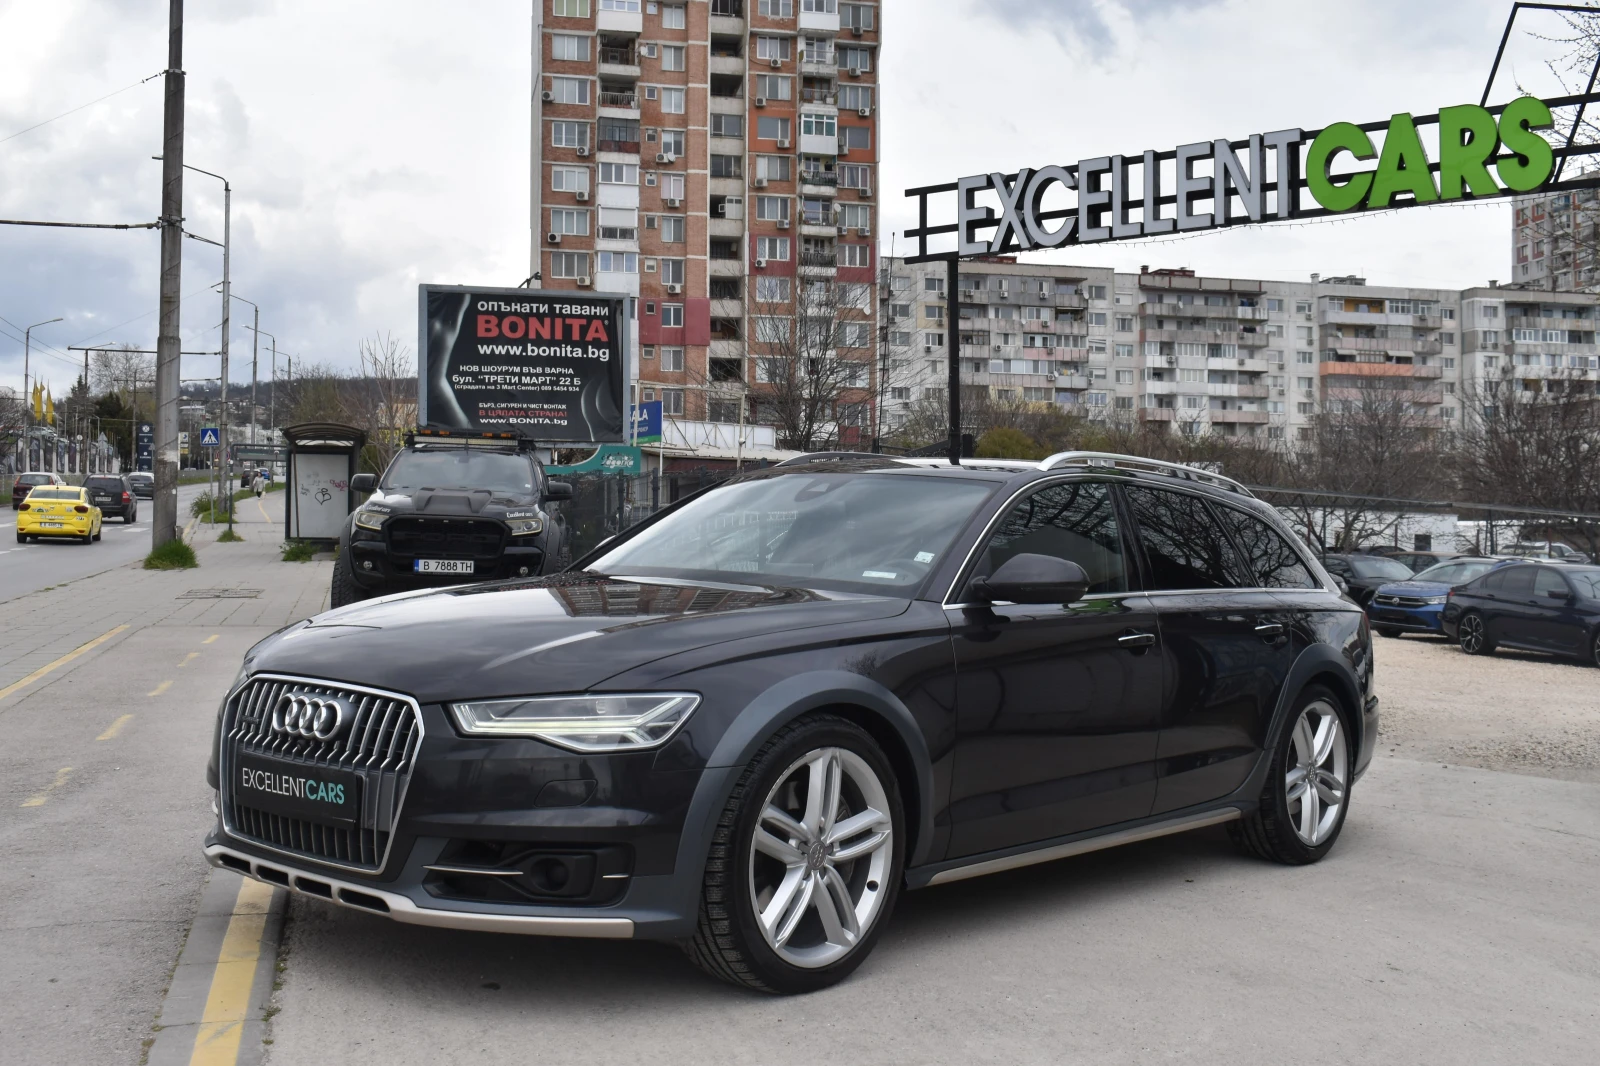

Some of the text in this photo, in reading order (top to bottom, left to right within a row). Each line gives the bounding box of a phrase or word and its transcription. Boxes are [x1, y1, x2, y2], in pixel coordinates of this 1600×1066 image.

[477, 300, 609, 316] опънати тавани
[477, 314, 608, 342] BONITA
[477, 343, 610, 362] www.bonita.bg
[481, 365, 521, 373] ШОУРУМ
[522, 366, 543, 374] ВЪВ
[544, 366, 574, 375] ВАРНА
[452, 374, 475, 384] бул.
[558, 377, 571, 385] 22
[479, 417, 568, 426] www.BONITA.bg
[423, 561, 473, 572] B 7888 TH
